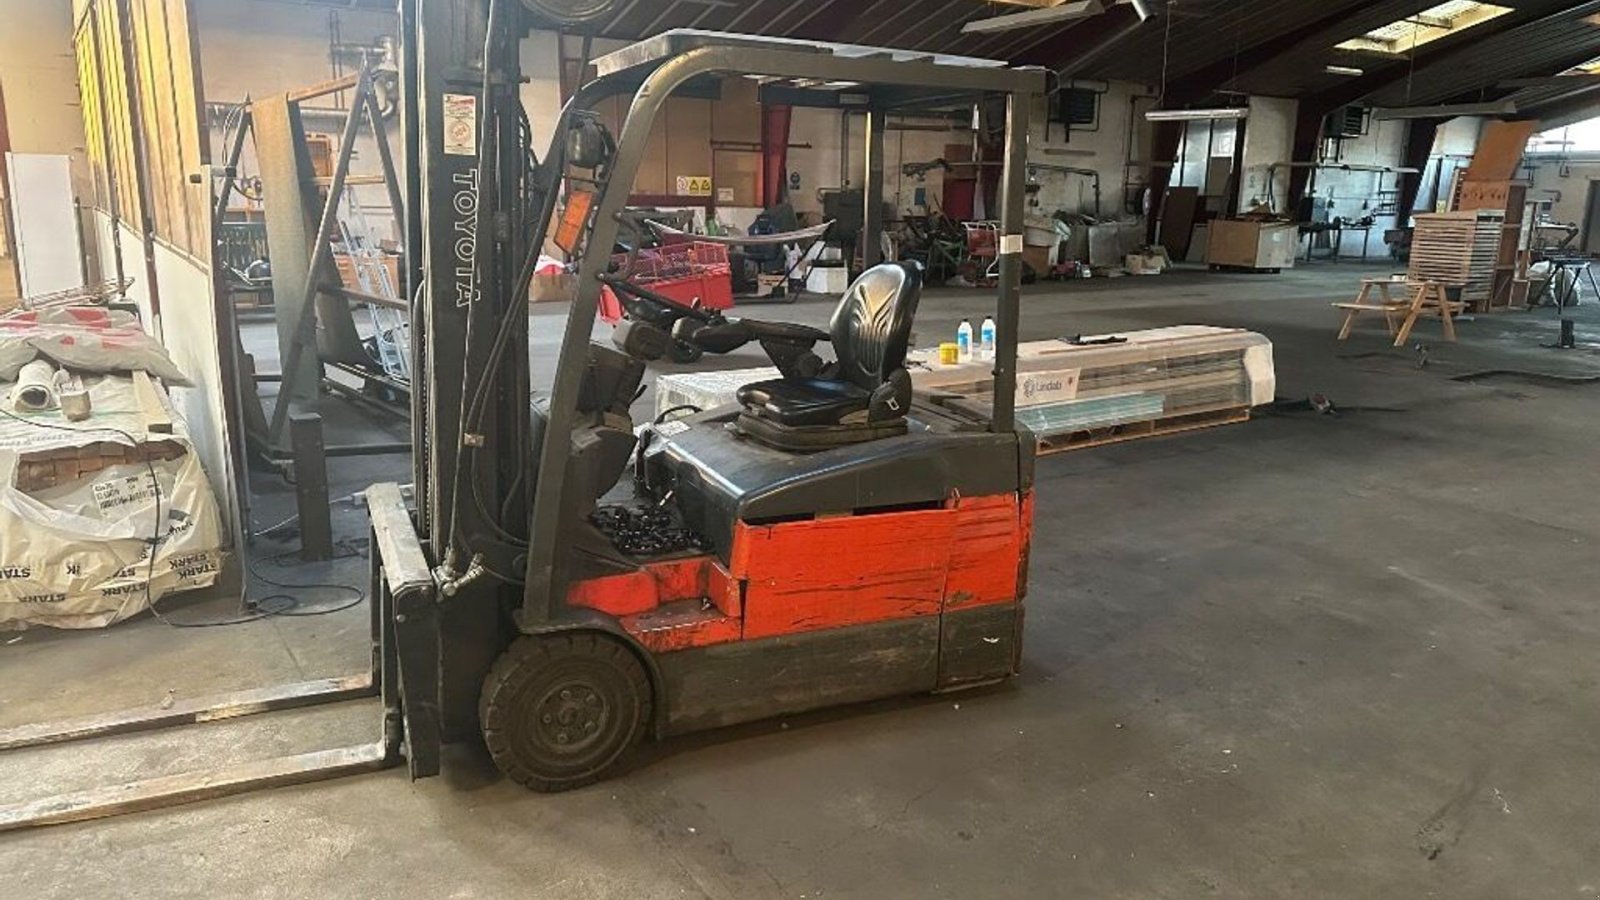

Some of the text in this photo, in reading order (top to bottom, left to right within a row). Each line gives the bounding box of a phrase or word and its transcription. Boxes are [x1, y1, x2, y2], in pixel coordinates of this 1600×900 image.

[453, 168, 480, 307] TOYOTA
[169, 554, 207, 570] STARK
[179, 562, 217, 581] STARK
[102, 582, 146, 597] STARK
